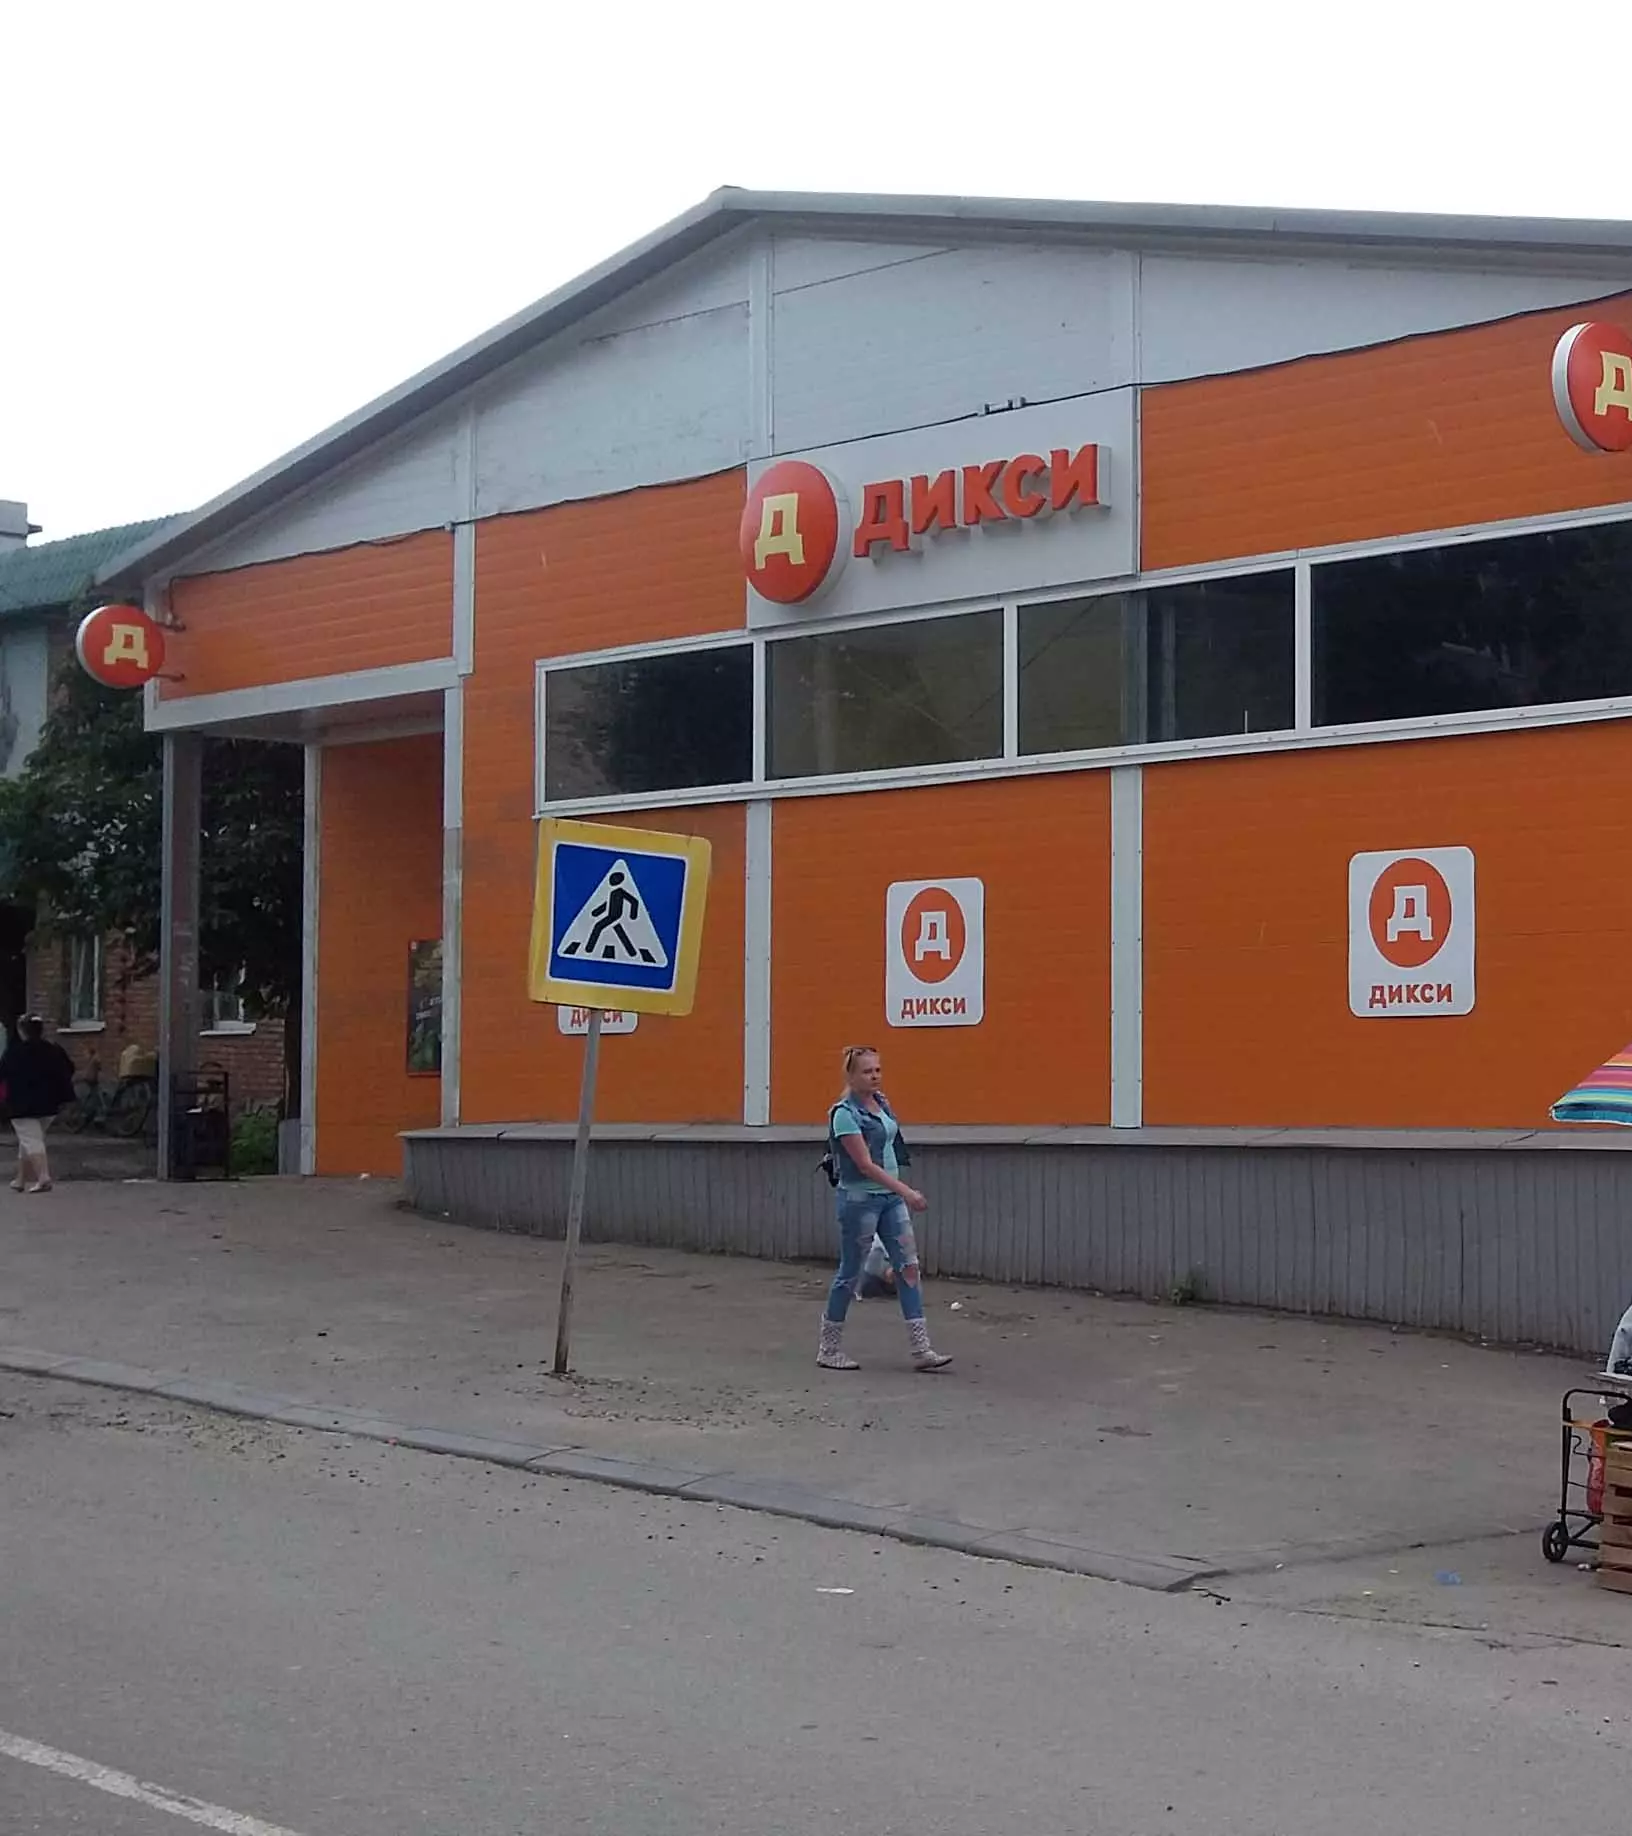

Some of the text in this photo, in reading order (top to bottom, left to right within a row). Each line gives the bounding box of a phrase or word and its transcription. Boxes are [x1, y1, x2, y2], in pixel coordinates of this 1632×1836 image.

[754, 443, 1102, 570] Д ДИКСИ
[104, 624, 148, 669] Д
[914, 911, 952, 961] Д
[1387, 885, 1434, 942] Д
[901, 997, 967, 1019] ДИКСИ
[1368, 983, 1453, 1008] ДИКСИ
